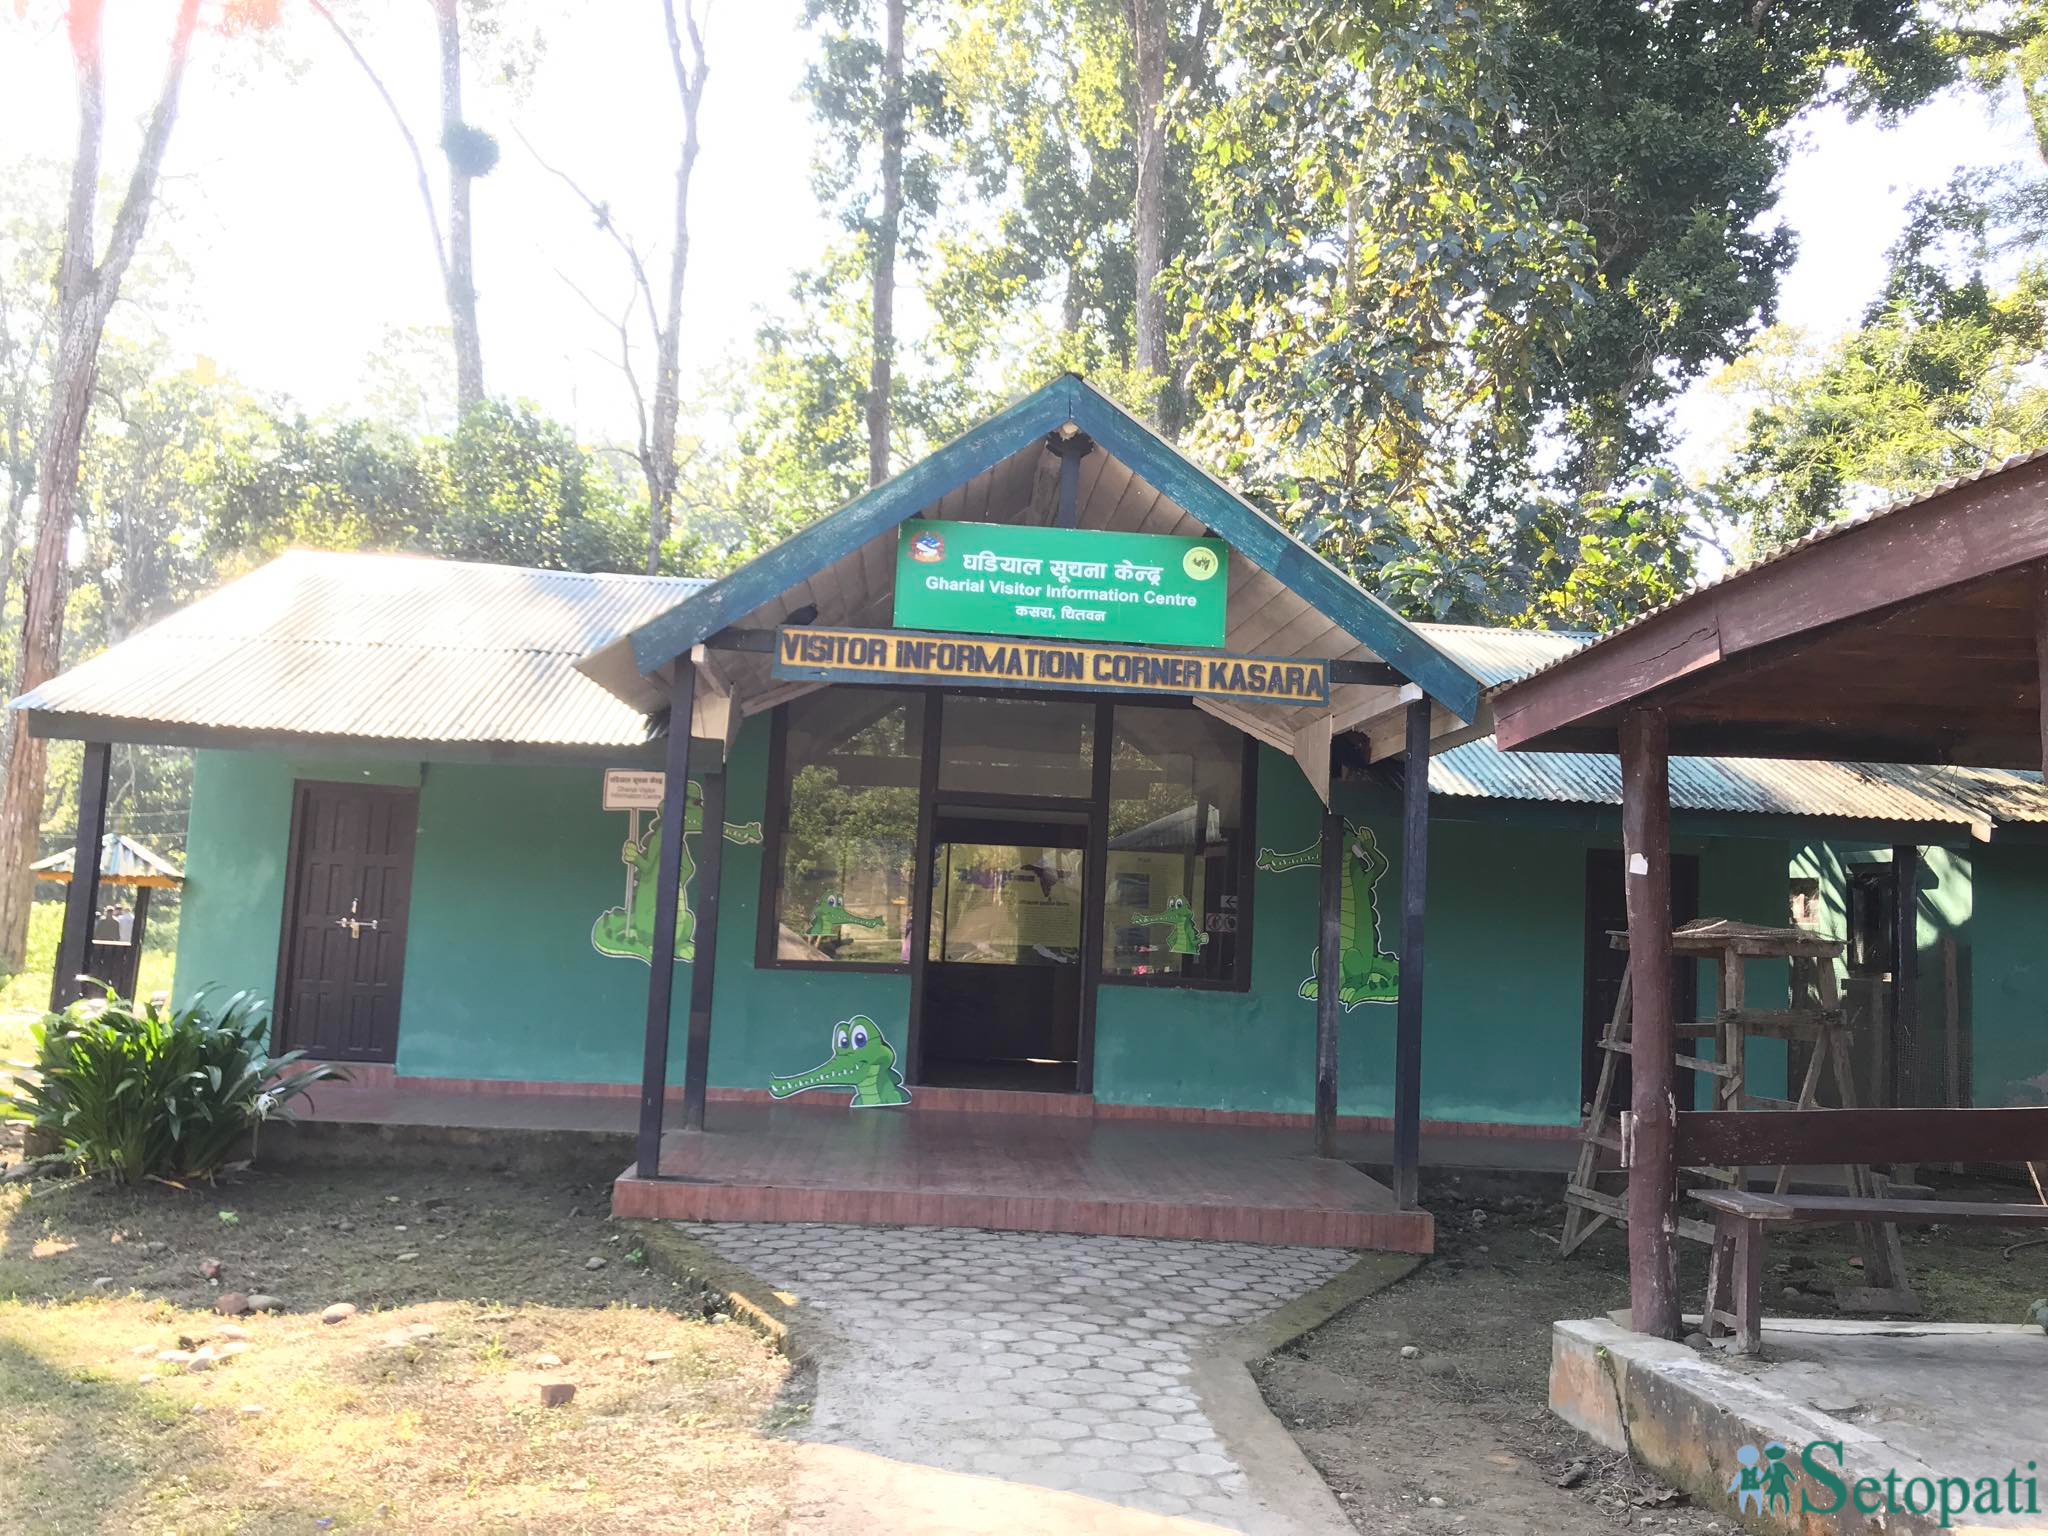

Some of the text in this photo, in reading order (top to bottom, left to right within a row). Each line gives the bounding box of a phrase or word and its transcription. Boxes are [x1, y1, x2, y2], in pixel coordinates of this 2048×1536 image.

[962, 550, 1164, 586] घडियाल सूचना केन्द्र
[926, 576, 1198, 607] Gharial Visitor Information Centre
[1015, 605, 1106, 622] कसरा, चितवन
[783, 632, 1322, 697] VISITOR INFORMATION CORNER KASARA
